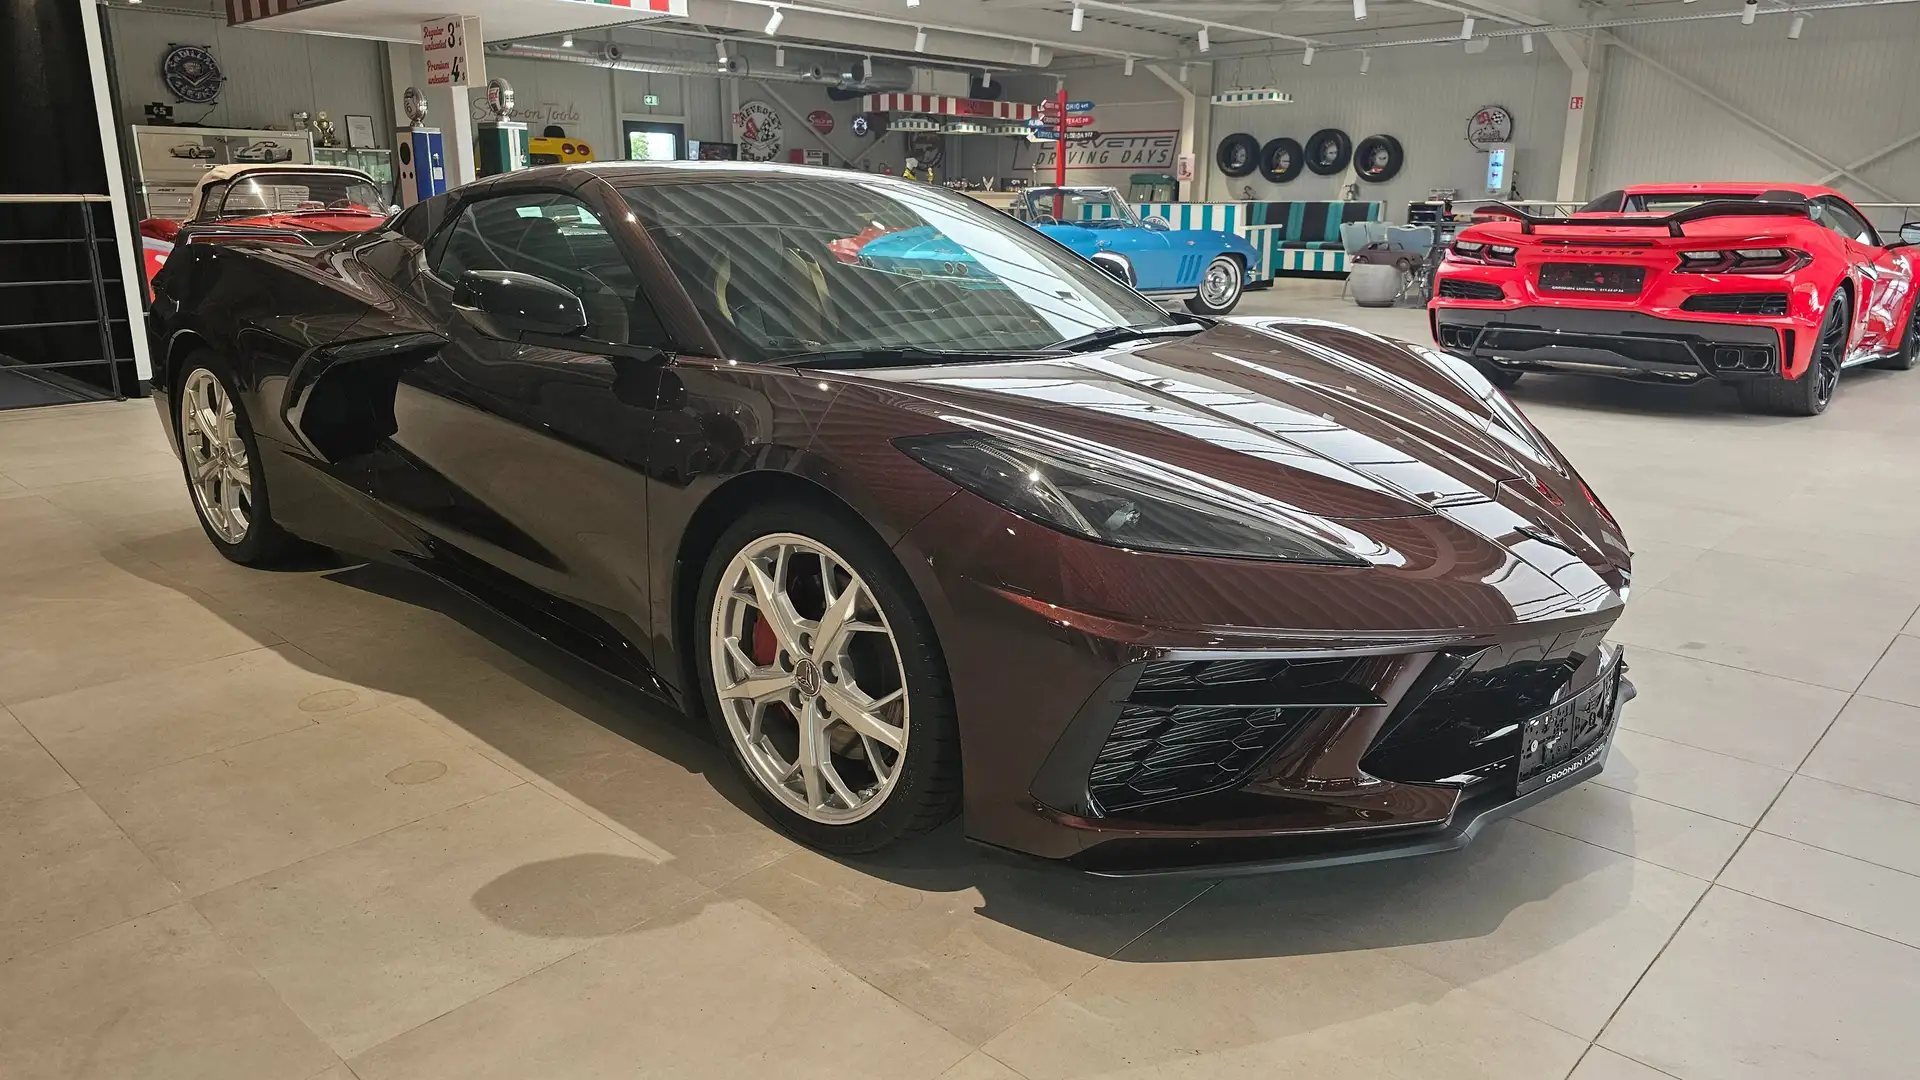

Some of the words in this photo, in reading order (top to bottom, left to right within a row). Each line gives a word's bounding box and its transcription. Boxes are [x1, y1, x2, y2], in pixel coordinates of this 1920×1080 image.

[423, 26, 444, 40] Regular
[447, 22, 456, 48] 3
[424, 39, 447, 51] unleaded
[168, 49, 216, 71] CADILLAC
[426, 60, 450, 73] Premium
[451, 56, 460, 82] 4
[427, 73, 450, 85] unleaded
[543, 102, 581, 124] Tools
[1065, 103, 1081, 111] OHIO
[1065, 116, 1082, 125] TEXAS
[1064, 132, 1084, 140] FLORIDA
[1036, 149, 1110, 166] DRVING
[1121, 149, 1170, 165] DAYS
[1541, 248, 1644, 256] CORVETTE
[1545, 760, 1582, 783] CROONEN
